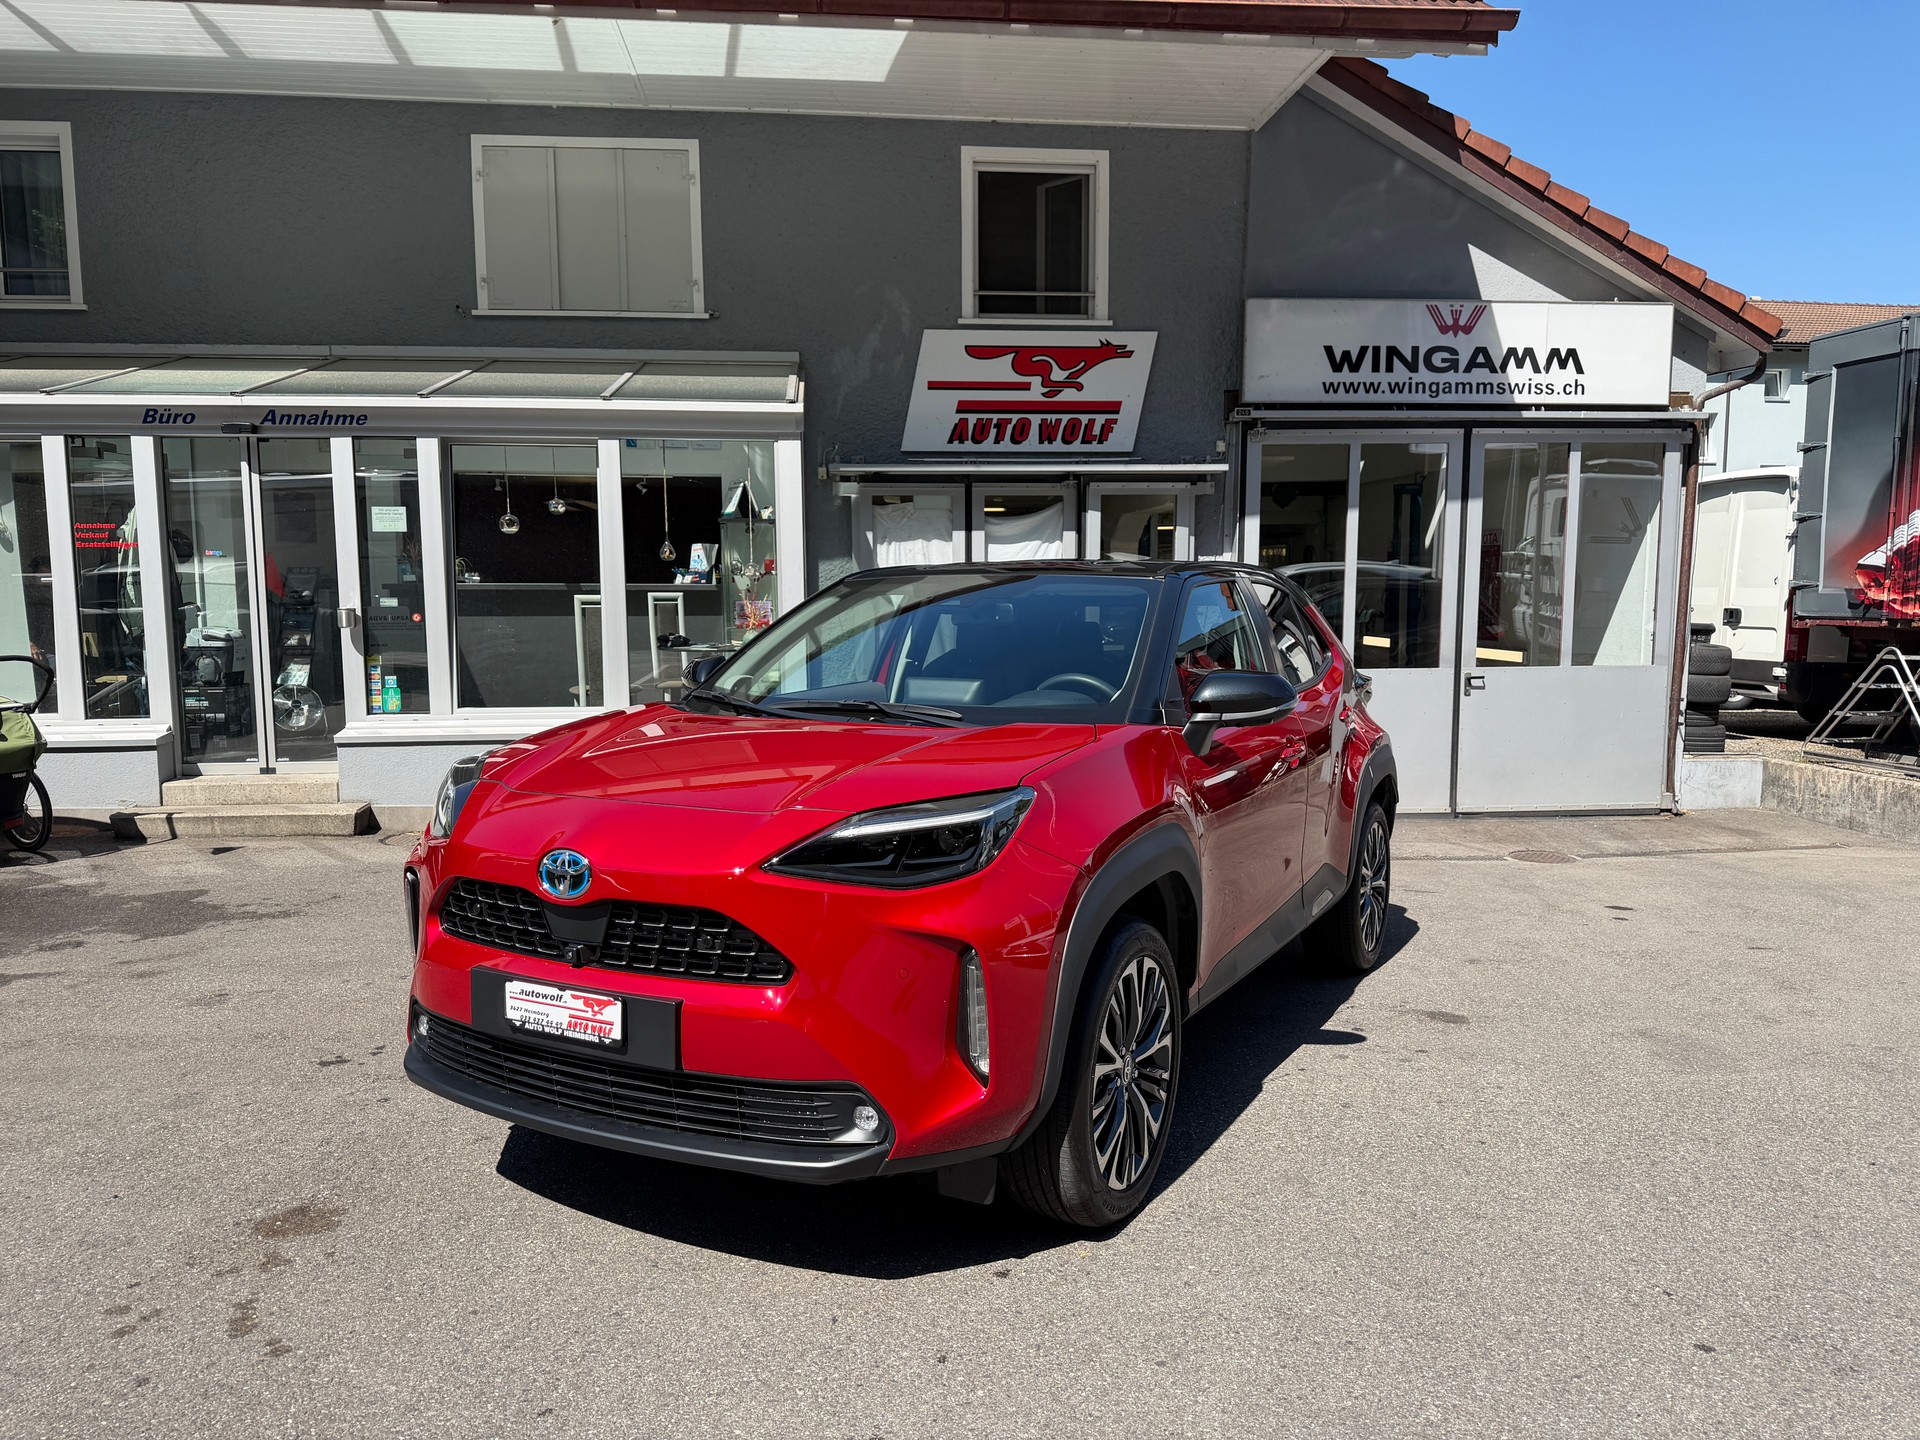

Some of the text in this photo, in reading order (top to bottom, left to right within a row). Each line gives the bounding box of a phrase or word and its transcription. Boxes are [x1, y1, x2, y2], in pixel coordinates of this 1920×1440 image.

[1323, 345, 1585, 374] WINGAMM
[1322, 377, 1585, 398] www.wingammswiss.ch
[142, 408, 195, 425] Büro
[260, 409, 368, 426] Annahme
[947, 417, 1118, 445] AUTO WOLF
[524, 1008, 549, 1018] Heimberg
[525, 1022, 599, 1042] AUTO WOLF HEIMBERG
[567, 1019, 613, 1037] AUTO WOLF
